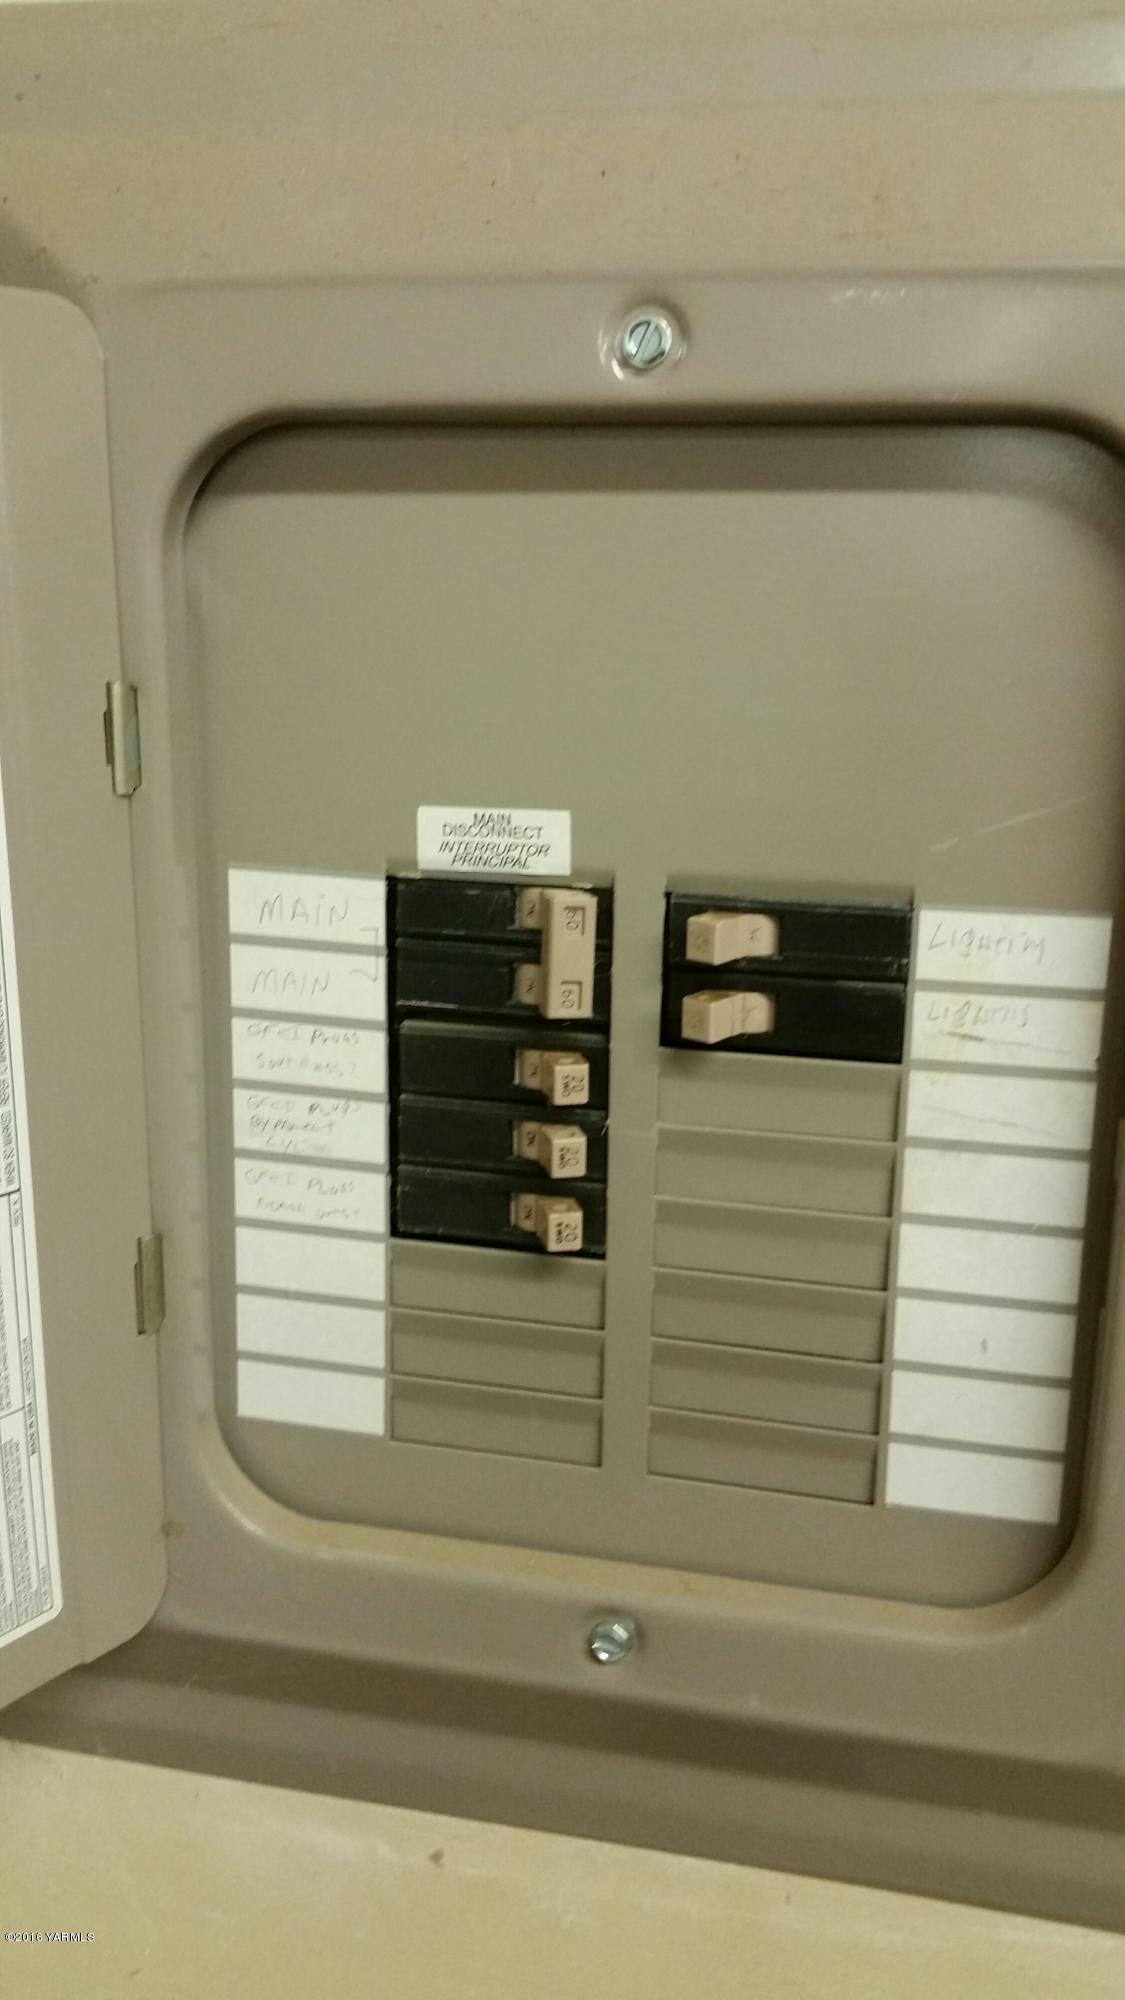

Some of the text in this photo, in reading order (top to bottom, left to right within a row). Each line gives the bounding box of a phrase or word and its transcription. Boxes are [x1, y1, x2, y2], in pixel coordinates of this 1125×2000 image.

[473, 812, 512, 828] MAIN
[442, 822, 544, 840] DISCONNECT
[438, 840, 551, 858] INTERRUPTOR
[451, 854, 531, 871] PRINCIPAL
[251, 967, 330, 997] MAIN
